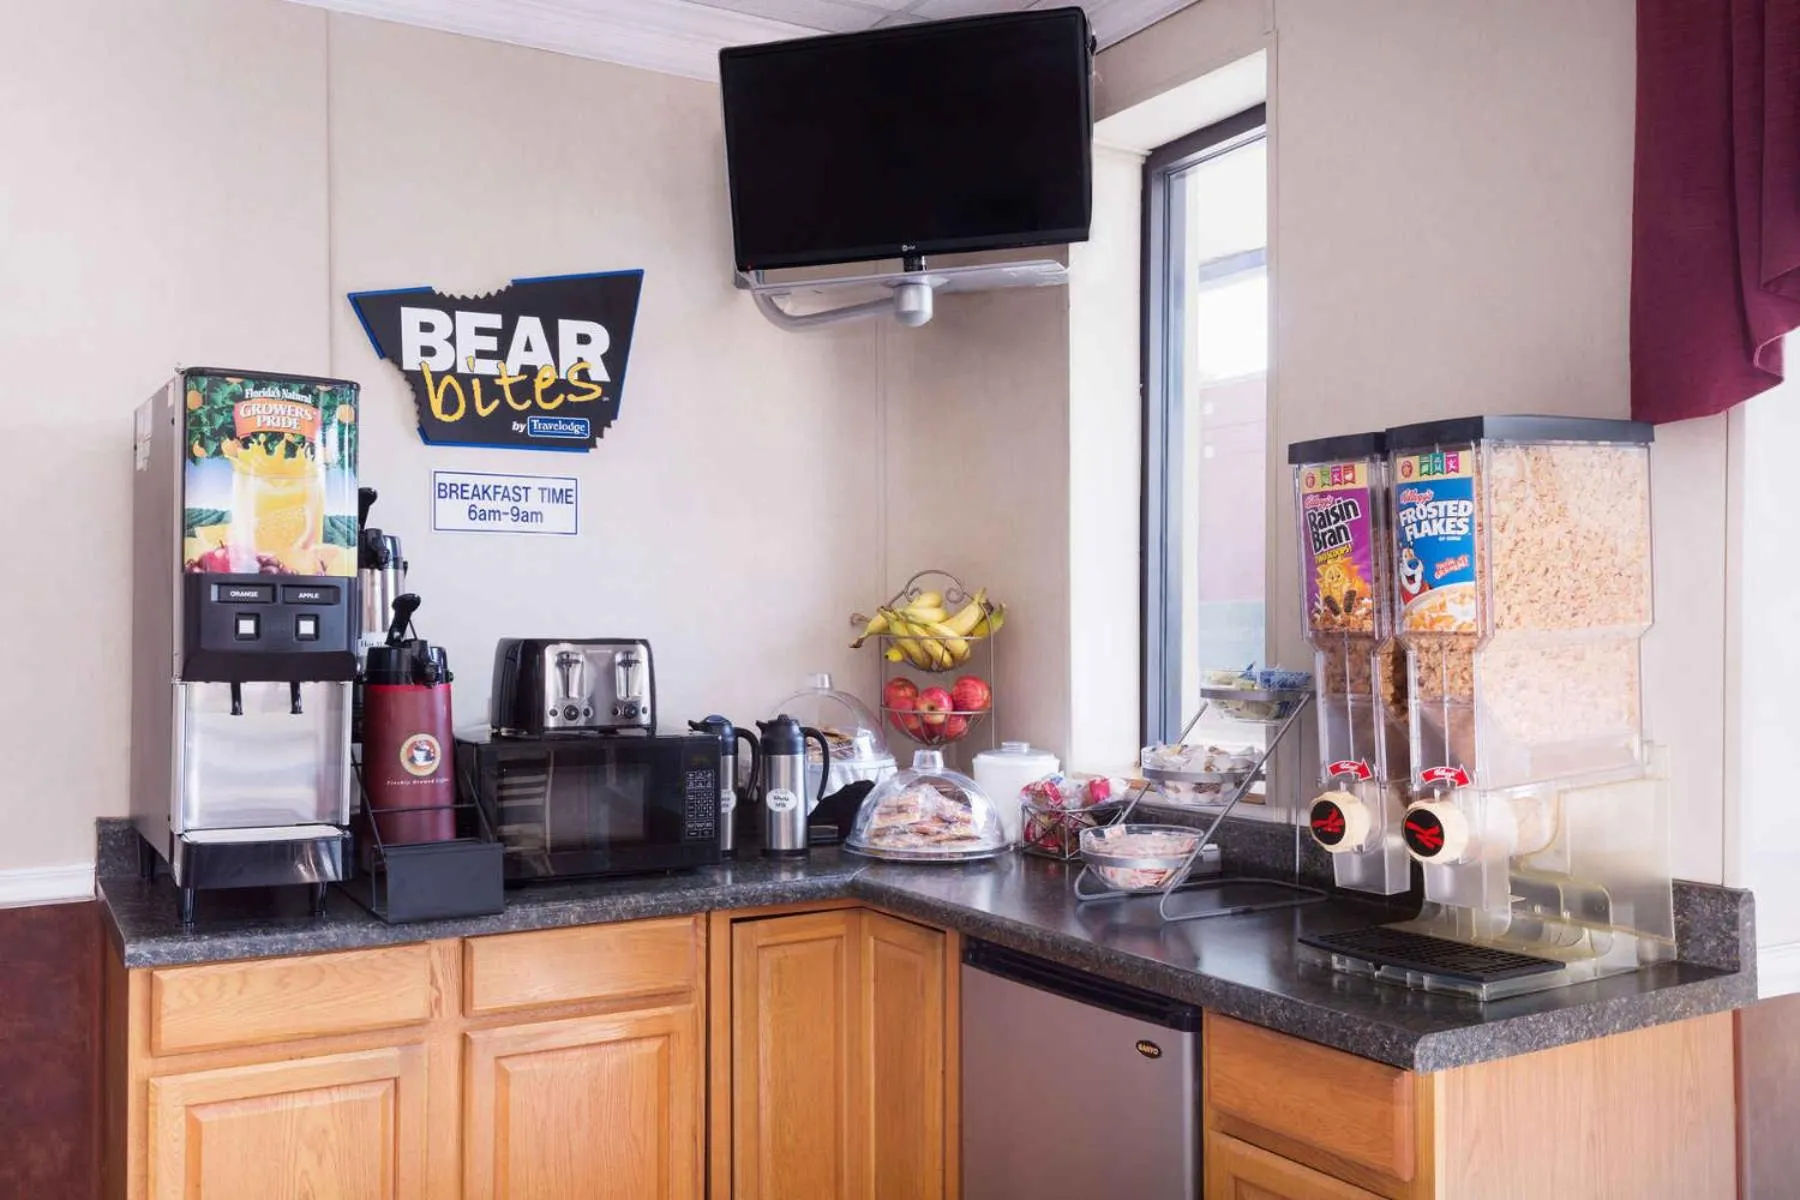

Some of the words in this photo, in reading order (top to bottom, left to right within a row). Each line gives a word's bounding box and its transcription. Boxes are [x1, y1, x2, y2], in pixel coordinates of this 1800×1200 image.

[400, 306, 611, 382] BEAR
[245, 387, 280, 400] Florida's
[281, 388, 312, 403] Natural
[419, 356, 603, 422] bites
[256, 414, 300, 430] PRIDE
[511, 421, 526, 432] by
[531, 419, 586, 434] Travelodge
[437, 482, 532, 502] BREAKFAST
[538, 487, 574, 504] TIME
[467, 504, 544, 523] 6am-9am
[1306, 498, 1360, 531] Raisin
[1399, 500, 1473, 526] FROSTED
[1312, 524, 1351, 553] Bran
[1404, 517, 1470, 539] FLAKES
